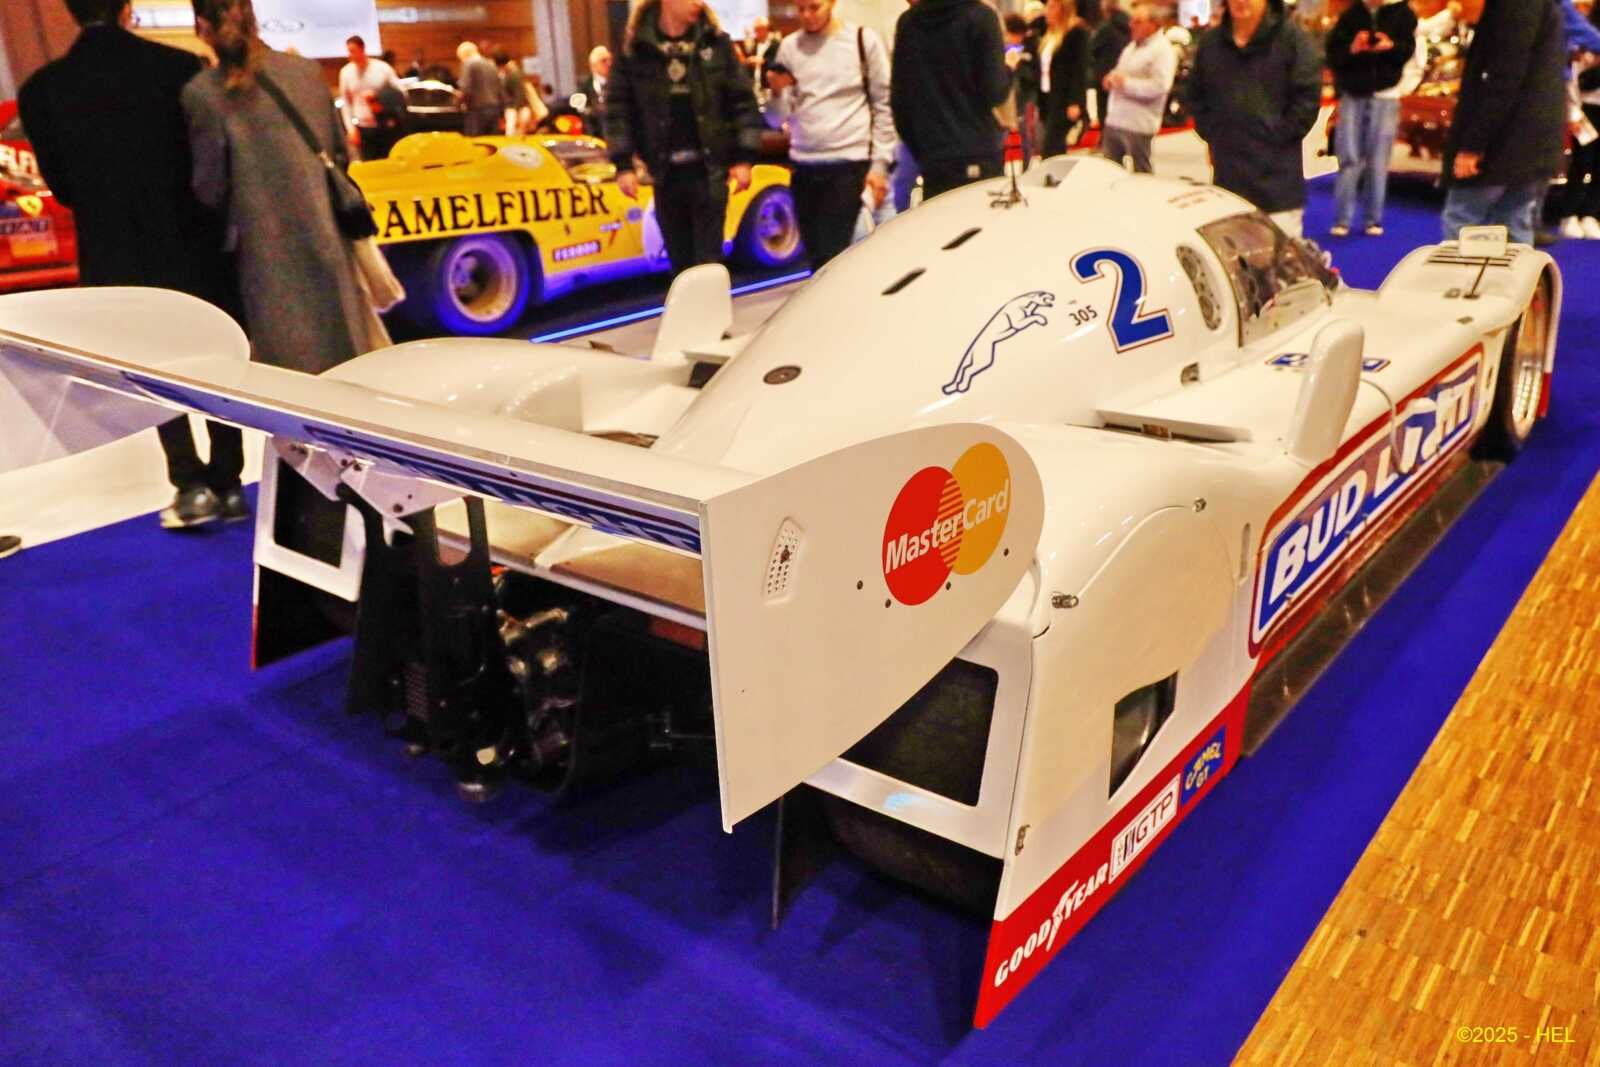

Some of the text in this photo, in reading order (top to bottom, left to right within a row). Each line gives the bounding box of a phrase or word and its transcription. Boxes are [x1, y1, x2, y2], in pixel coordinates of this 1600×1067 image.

[368, 184, 610, 239] AMELFILTER
[1069, 246, 1174, 353] 2
[1069, 305, 1098, 327] 305
[885, 478, 1009, 575] MasterCard
[1269, 469, 1368, 605] BUD
[1136, 791, 1173, 843] GTP
[994, 862, 1109, 987] GOODYEAR
